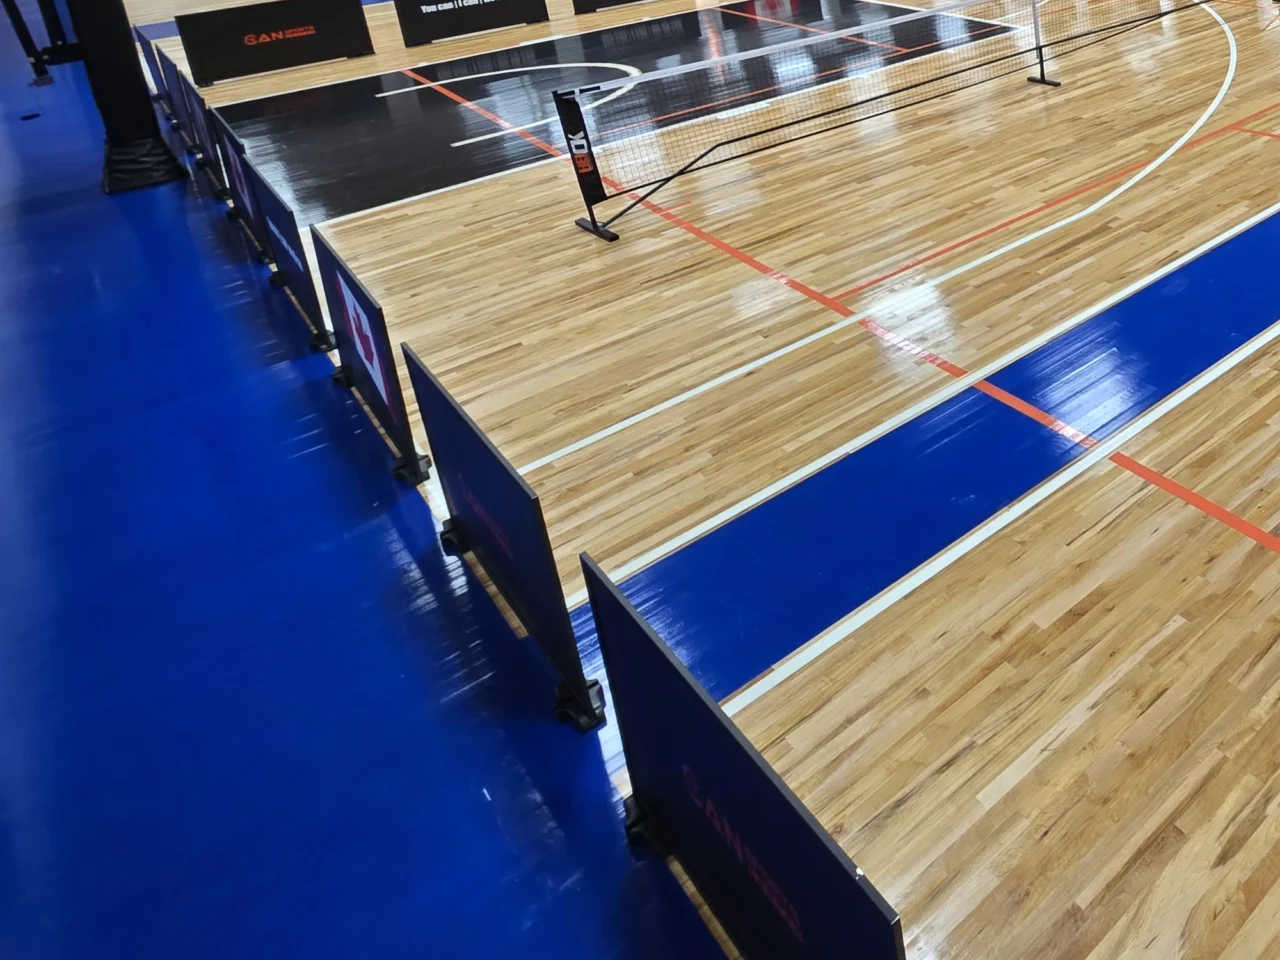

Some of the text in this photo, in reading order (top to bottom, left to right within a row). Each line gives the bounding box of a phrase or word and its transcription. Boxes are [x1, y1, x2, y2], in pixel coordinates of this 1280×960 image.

[421, 5, 437, 13] You
[438, 2, 454, 10] can
[244, 30, 284, 45] CAN
